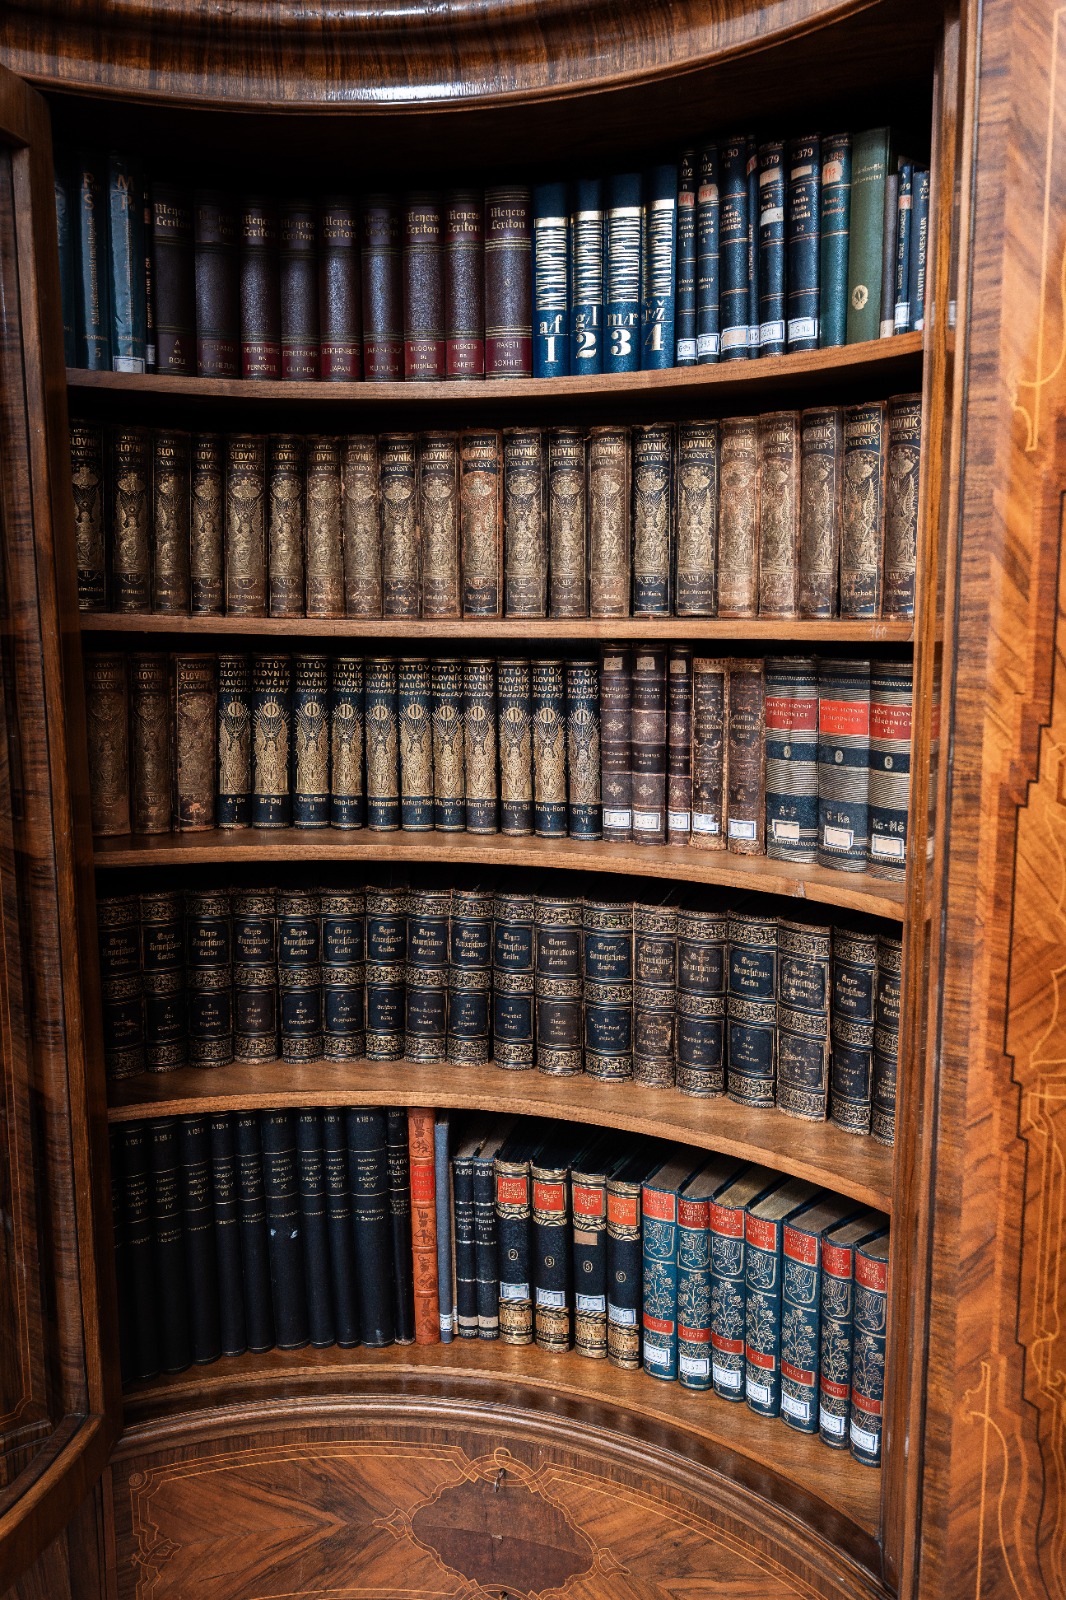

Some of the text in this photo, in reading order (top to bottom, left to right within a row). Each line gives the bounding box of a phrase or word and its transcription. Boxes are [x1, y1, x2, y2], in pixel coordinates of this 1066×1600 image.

[117, 173, 134, 191] M
[84, 193, 95, 210] S
[490, 207, 526, 218] Meyers
[491, 219, 526, 230] Lexikon
[571, 220, 603, 306] ENCYKLOPEDIE
[607, 216, 640, 302] ENCYKLOPEDIE
[642, 210, 673, 297] ENCYKLOPEDIE
[535, 228, 567, 310] ENCYKLOPEDIE
[545, 336, 559, 363] 1
[575, 331, 597, 359] 2
[610, 328, 631, 356] 3
[645, 322, 664, 351] 4
[95, 346, 103, 358] 5
[682, 438, 713, 449] SLOVNÍK
